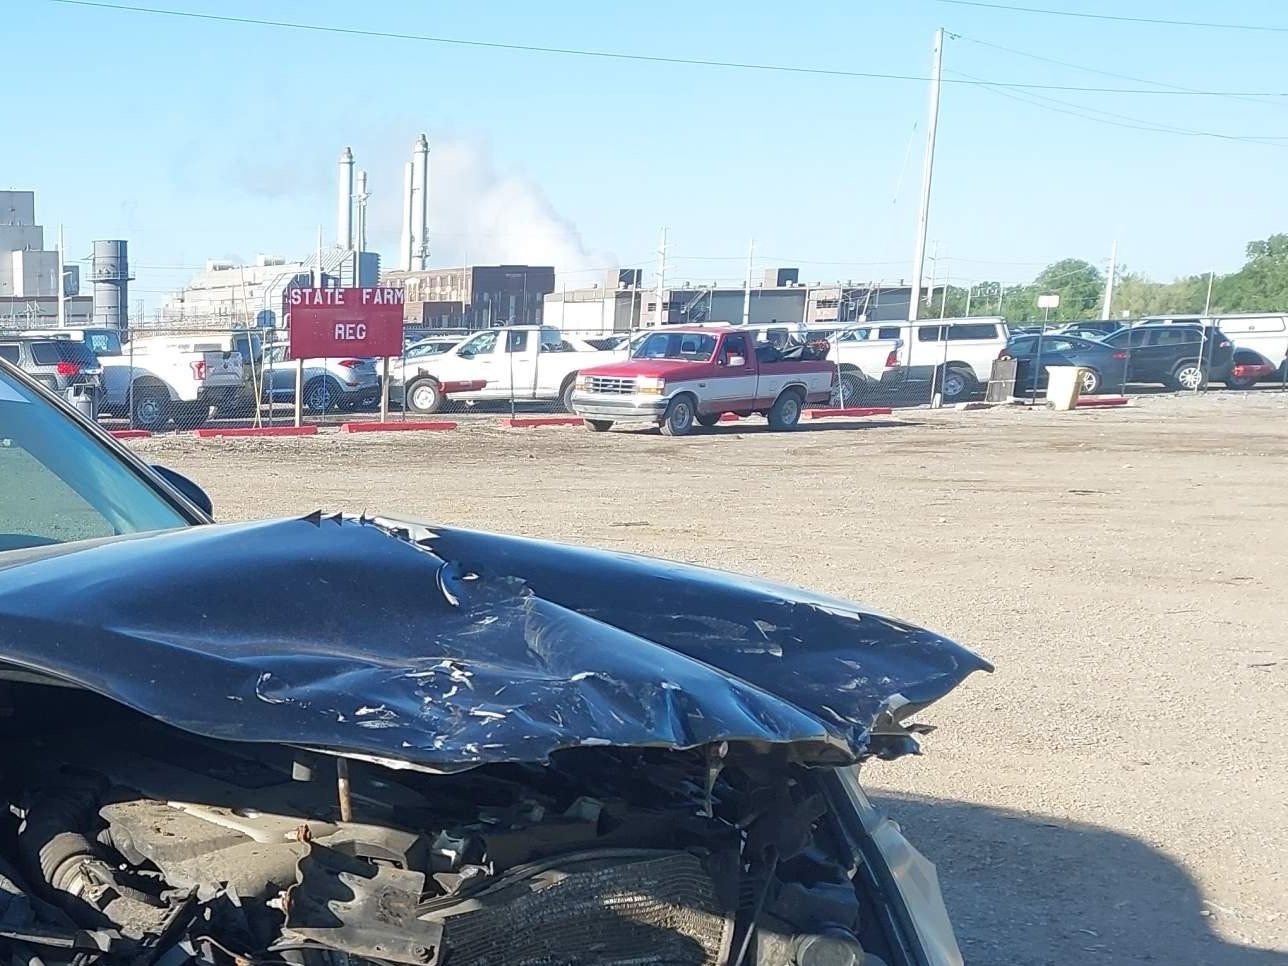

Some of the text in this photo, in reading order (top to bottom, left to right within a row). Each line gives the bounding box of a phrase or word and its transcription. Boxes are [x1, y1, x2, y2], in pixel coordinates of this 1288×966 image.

[291, 288, 405, 305] STATE FARM
[334, 323, 367, 340] REG
